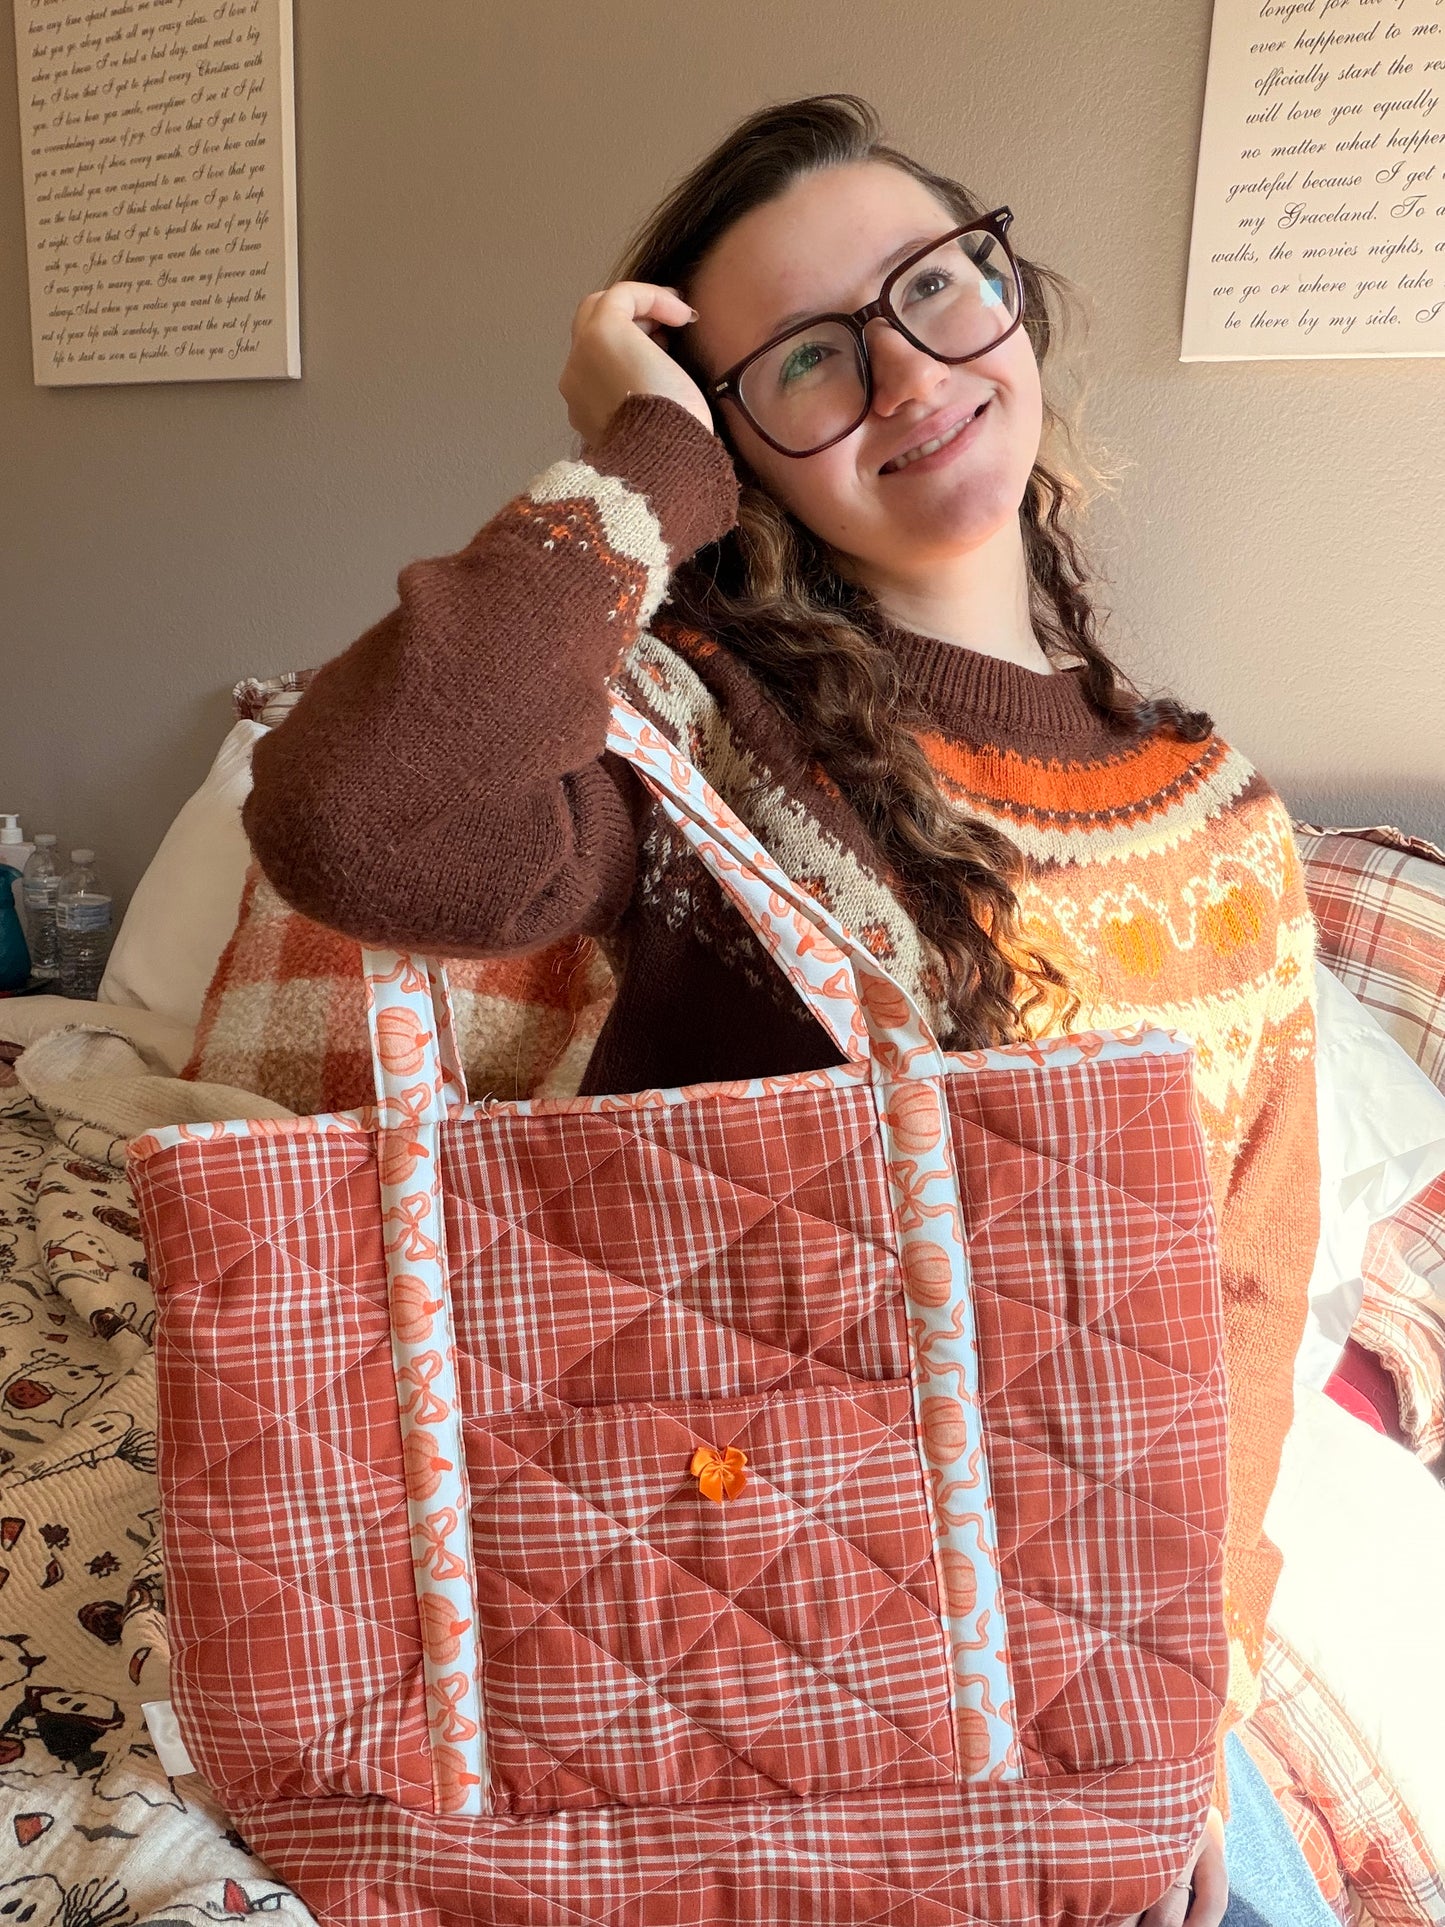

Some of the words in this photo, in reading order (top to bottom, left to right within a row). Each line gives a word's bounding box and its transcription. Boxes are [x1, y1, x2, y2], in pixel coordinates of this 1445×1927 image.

[1250, 40, 1286, 53] ever
[1293, 20, 1381, 55] happened
[1384, 22, 1400, 39] to
[1412, 23, 1441, 36] me.
[1254, 62, 1329, 96] officially
[1337, 60, 1381, 80] start
[1387, 54, 1413, 75] the
[1245, 102, 1283, 124] will
[1286, 100, 1321, 120] love
[1328, 104, 1363, 126] you
[1373, 88, 1439, 120] equally
[150, 119, 164, 136] I
[164, 120, 182, 134] love
[185, 116, 203, 131] that
[206, 110, 221, 127] I
[220, 112, 236, 132] get
[238, 111, 246, 122] to
[1240, 148, 1260, 159] no
[1270, 138, 1326, 157] matter
[1335, 130, 1381, 152] what
[160, 174, 169, 185] to
[192, 164, 206, 181] I
[206, 164, 224, 179] love
[228, 161, 246, 176] that
[1225, 171, 1298, 203] grateful
[1301, 170, 1362, 189] because
[1375, 160, 1406, 183] I
[1401, 164, 1436, 191] get
[1238, 217, 1265, 235] my
[1277, 200, 1379, 229] Graceland.
[1390, 194, 1427, 218] To
[72, 229, 85, 245] I
[86, 230, 101, 243] love
[104, 228, 121, 242] that
[124, 223, 137, 239] I
[136, 226, 151, 244] get
[153, 226, 160, 236] to
[1211, 242, 1258, 263] walks,
[1268, 241, 1293, 260] the
[1302, 241, 1358, 258] movies
[1368, 234, 1423, 263] nights,
[111, 249, 124, 265] I
[224, 236, 239, 253] I
[1212, 286, 1234, 296] we
[1238, 285, 1260, 303] go
[1270, 284, 1290, 294] or
[1297, 273, 1346, 293] where
[1352, 280, 1388, 299] you
[1397, 269, 1433, 289] take
[1224, 310, 1241, 328] be
[1249, 310, 1289, 328] there
[1297, 308, 1319, 335] by
[1328, 316, 1357, 334] my
[1365, 305, 1400, 325] side.
[174, 340, 187, 356] I
[188, 342, 205, 356] love
[227, 336, 260, 360] John!
